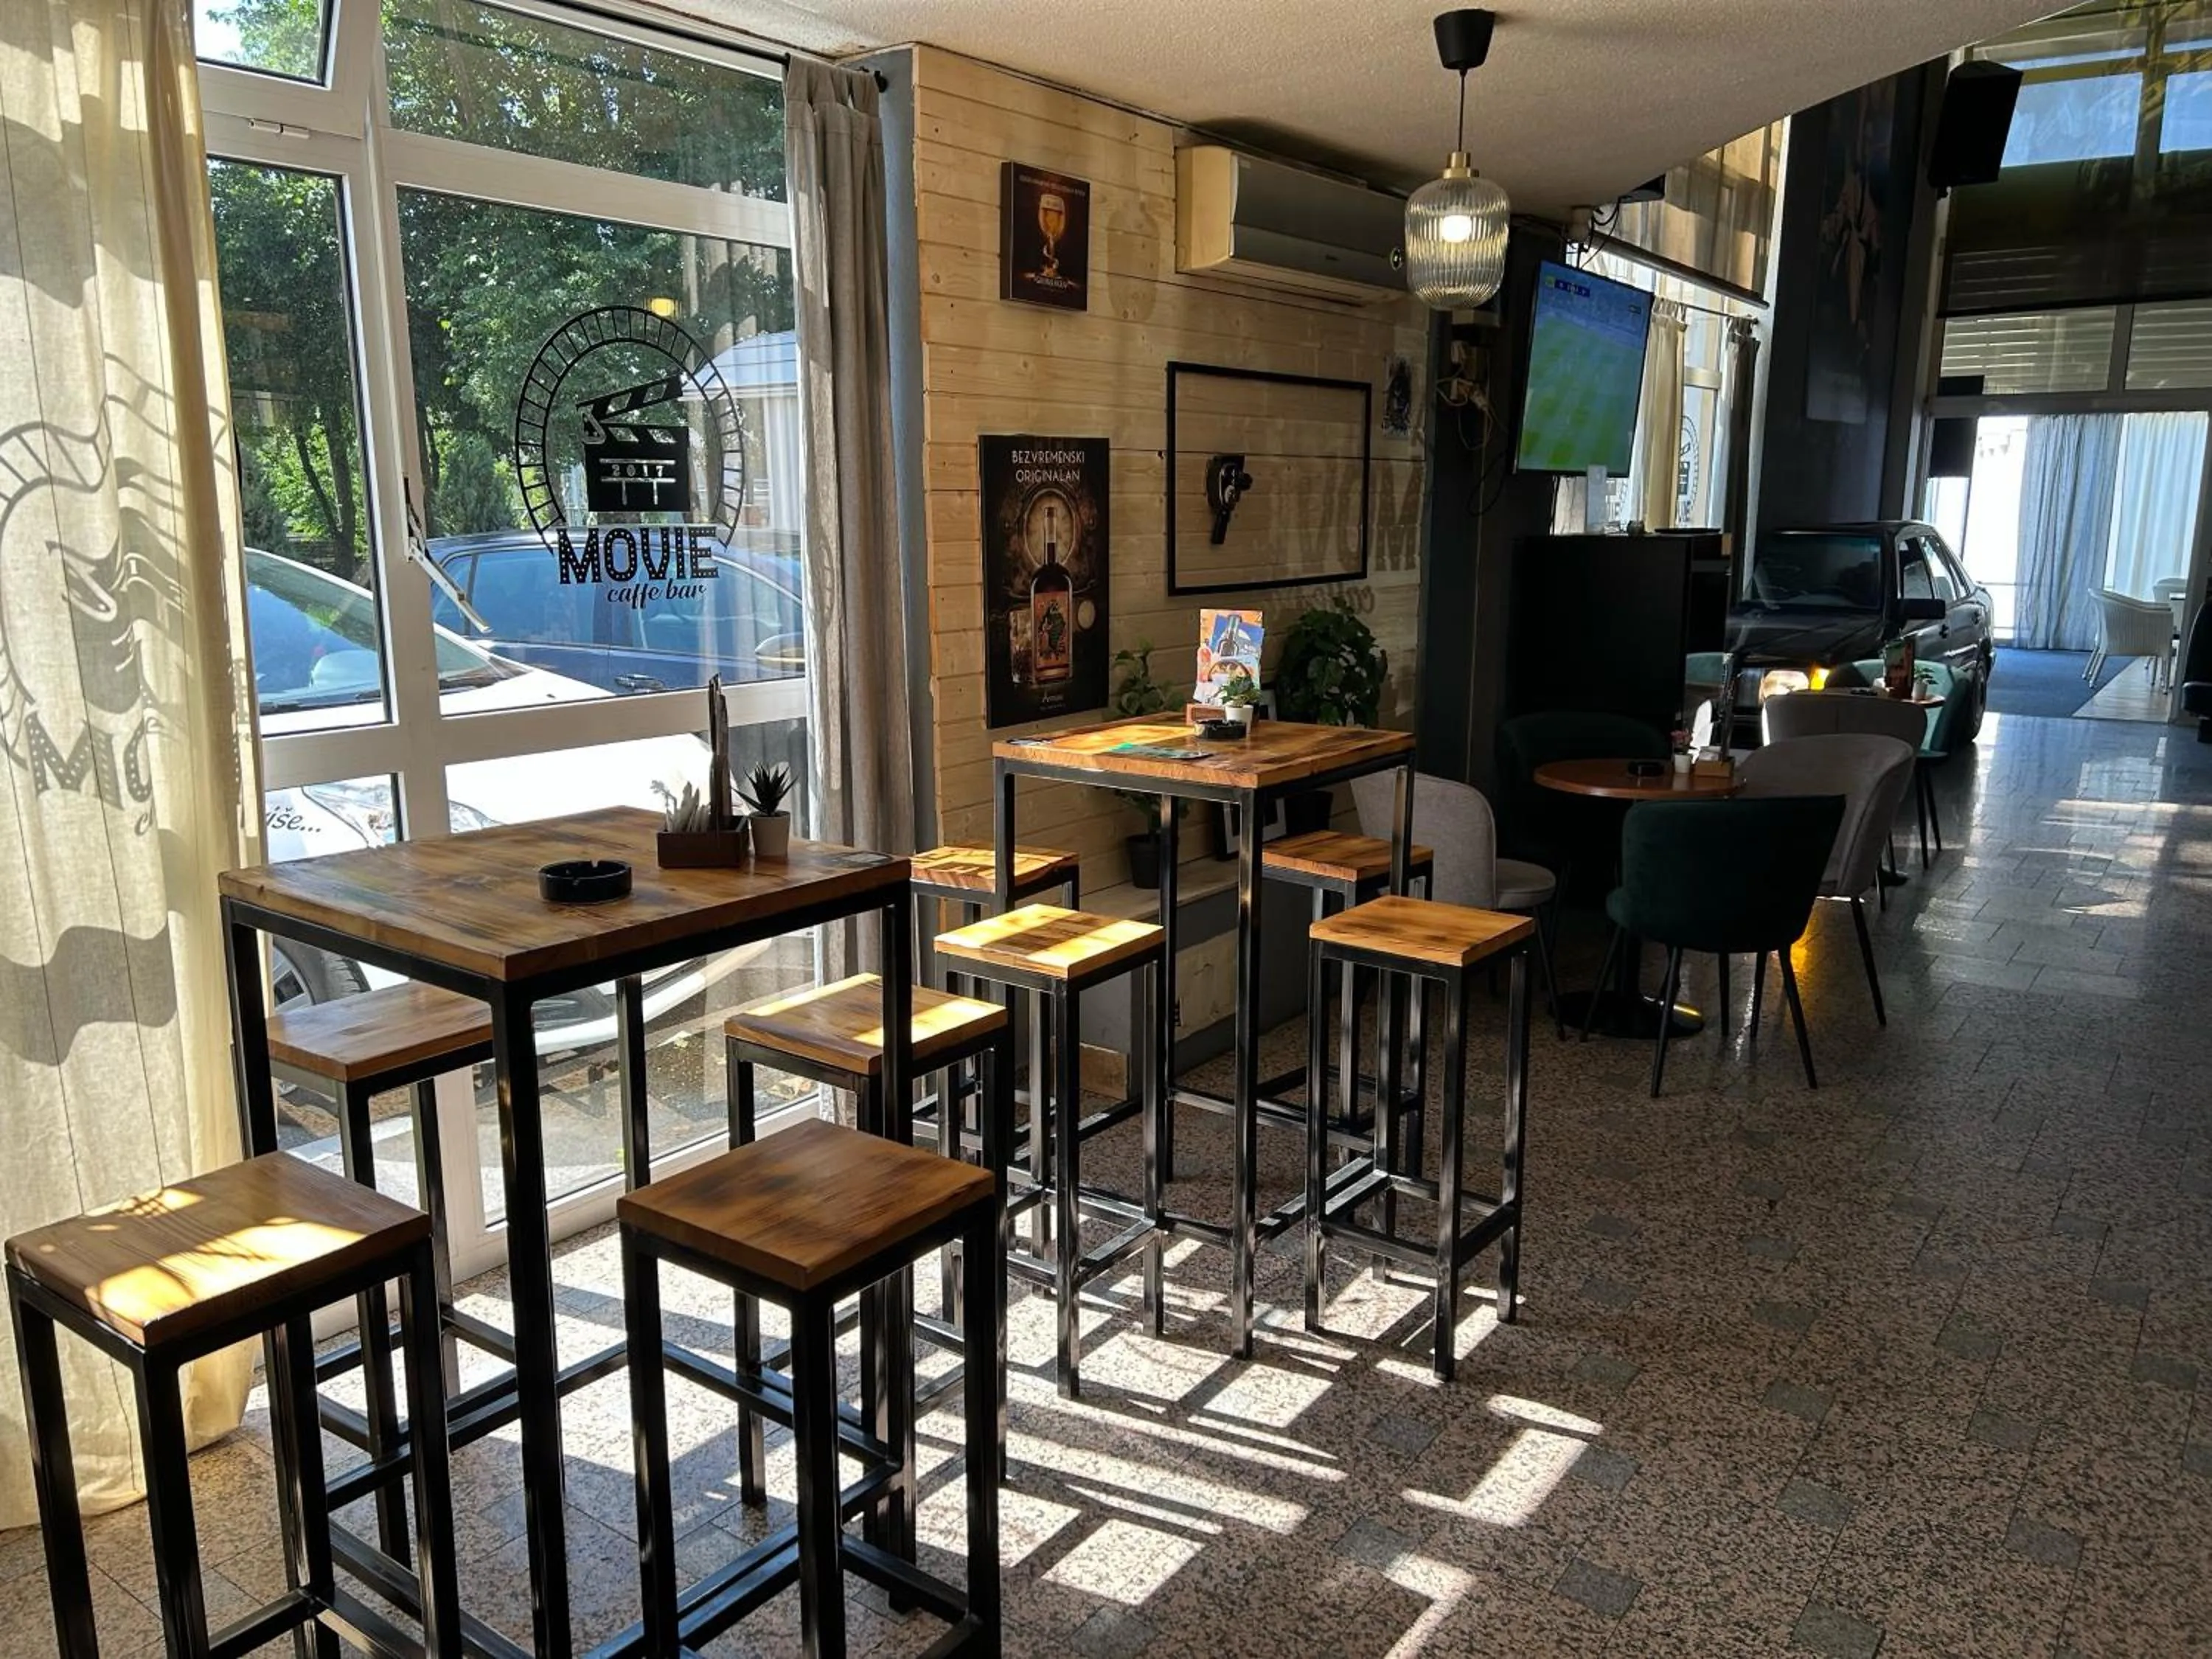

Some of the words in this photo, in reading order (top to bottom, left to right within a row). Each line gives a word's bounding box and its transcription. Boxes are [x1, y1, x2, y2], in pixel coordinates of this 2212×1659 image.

[611, 464, 665, 478] 2017
[1016, 470, 1080, 482] ORIGINALAN
[557, 527, 719, 584] MOVIE
[607, 583, 663, 610] caffe
[665, 577, 708, 601] bar
[265, 805, 322, 832] iše...
